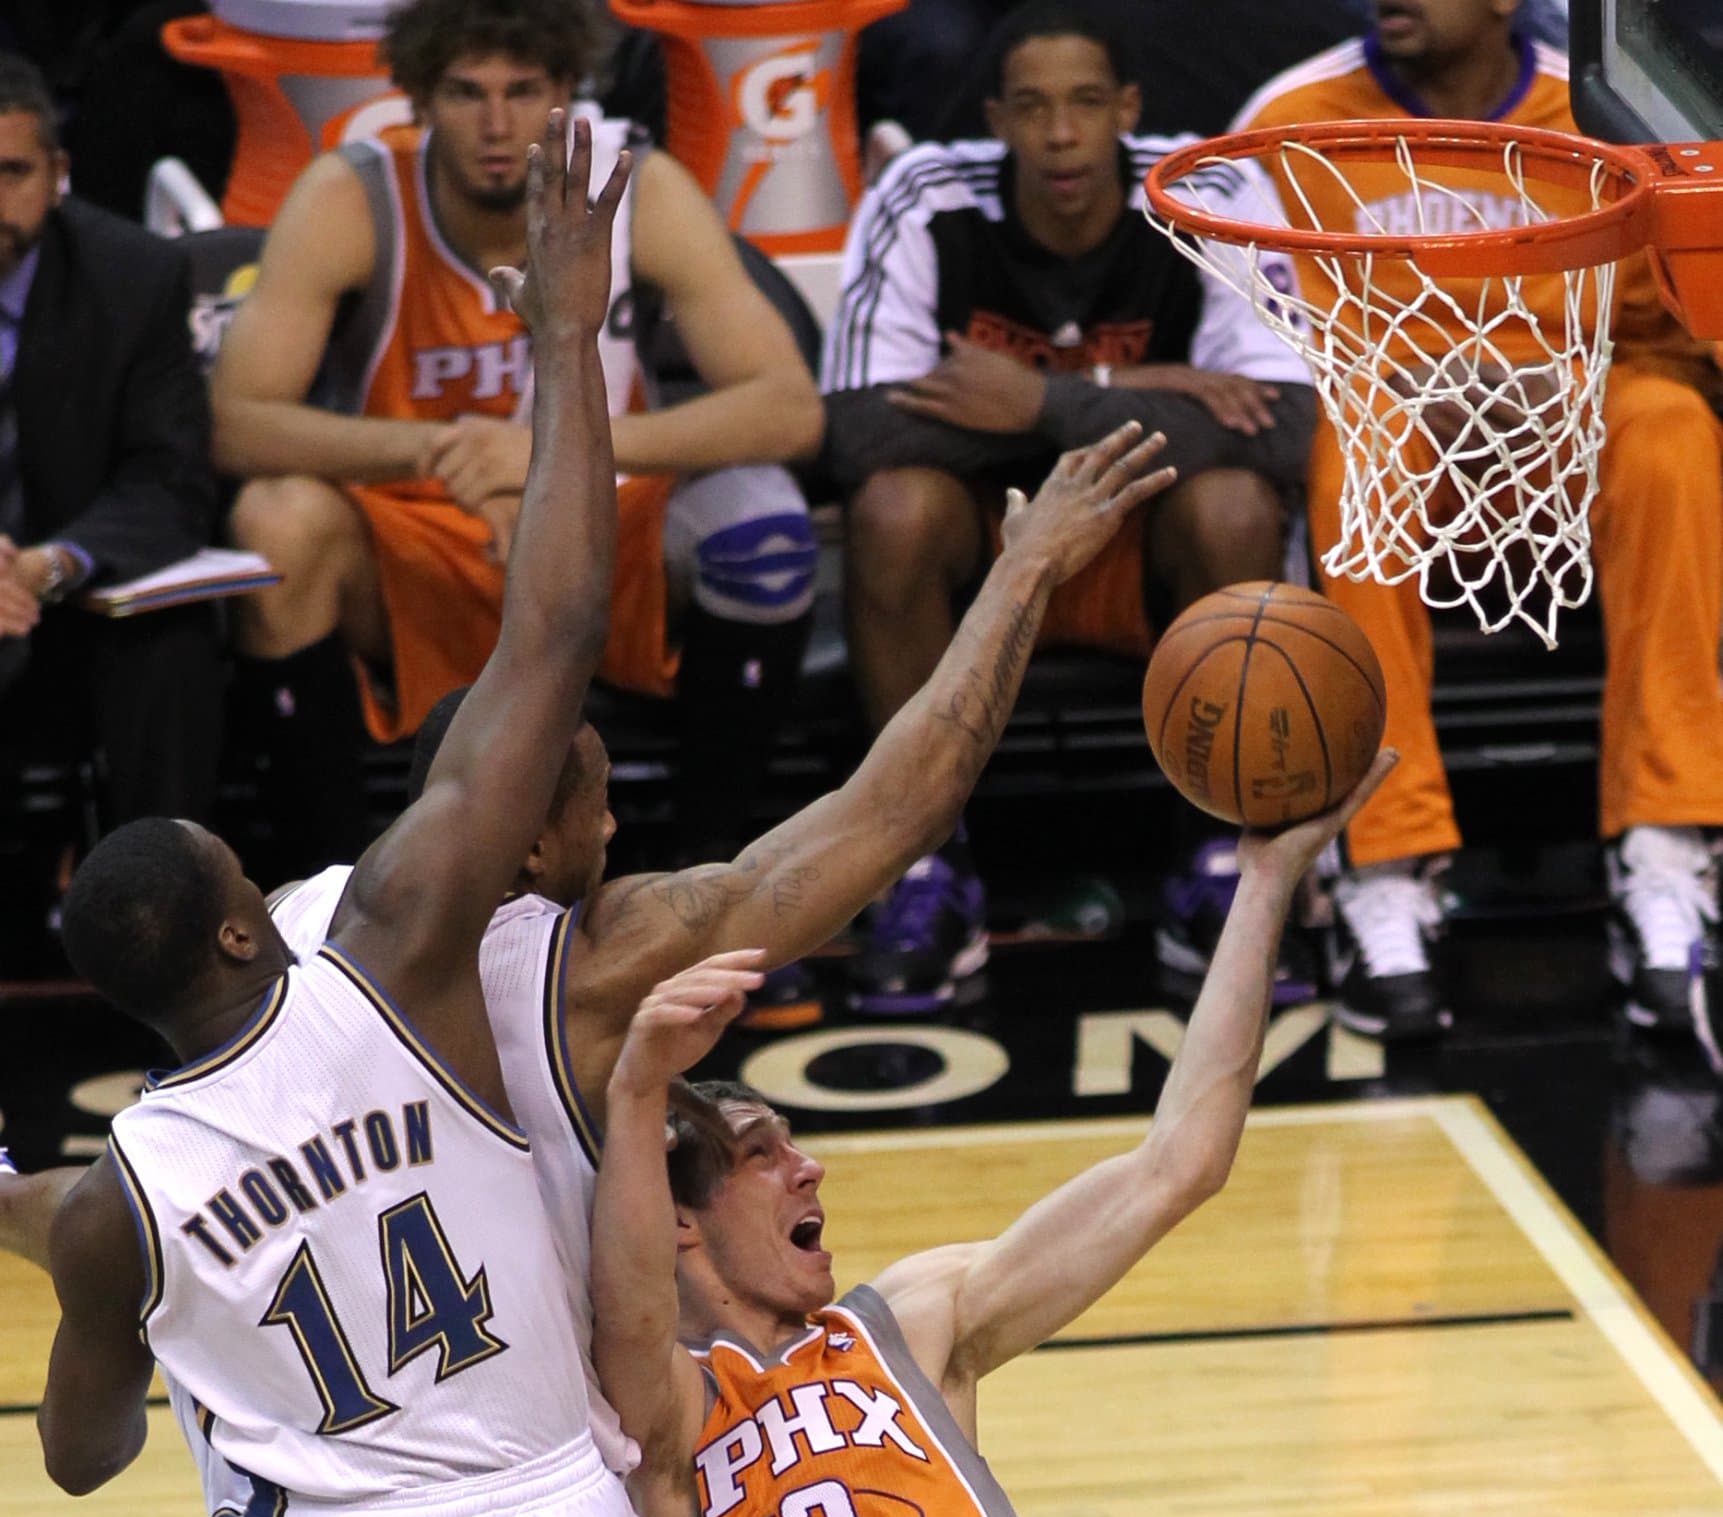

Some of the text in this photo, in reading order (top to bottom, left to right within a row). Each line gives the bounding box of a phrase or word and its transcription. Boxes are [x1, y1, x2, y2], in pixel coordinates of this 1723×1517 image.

[742, 54, 816, 138] G
[411, 335, 534, 399] PH
[180, 1100, 434, 1269] THORNTON
[258, 1191, 510, 1435] 14
